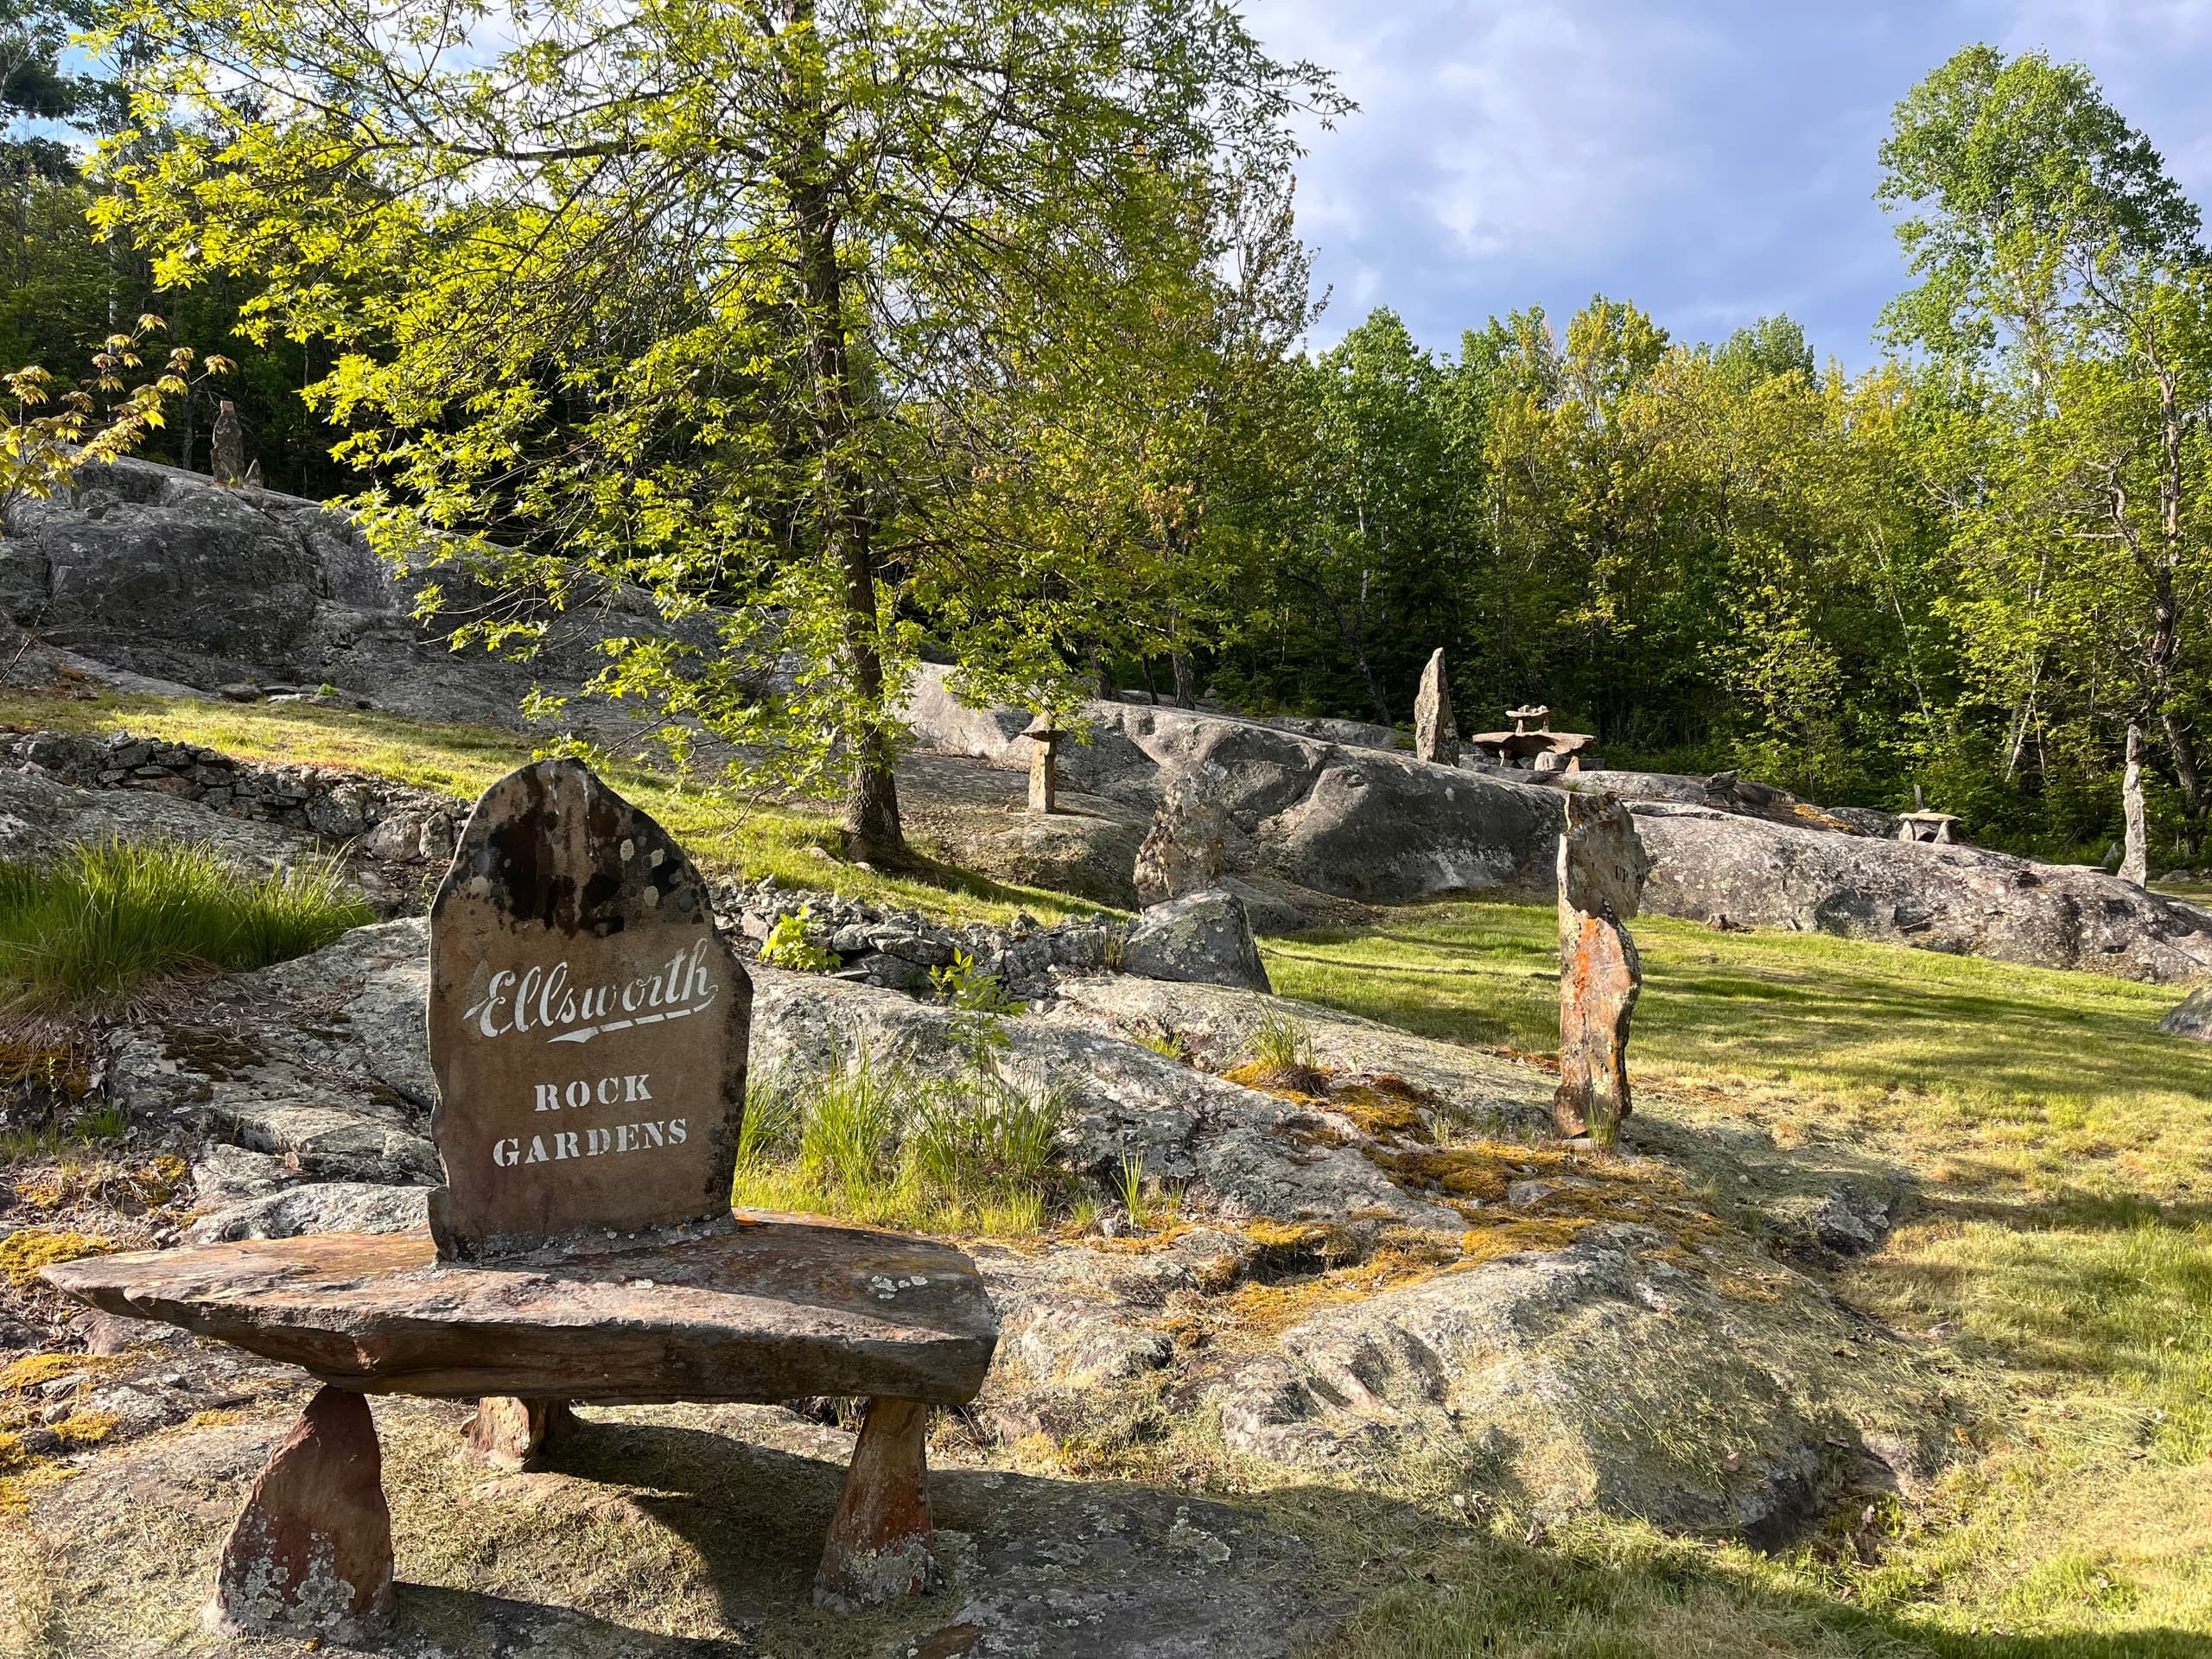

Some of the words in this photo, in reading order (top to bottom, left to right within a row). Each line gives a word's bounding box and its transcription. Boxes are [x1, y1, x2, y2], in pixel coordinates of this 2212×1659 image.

[462, 938, 719, 1038] Ellsworth
[534, 1073, 653, 1112] ROCK
[492, 1118, 688, 1167] GARDENS
